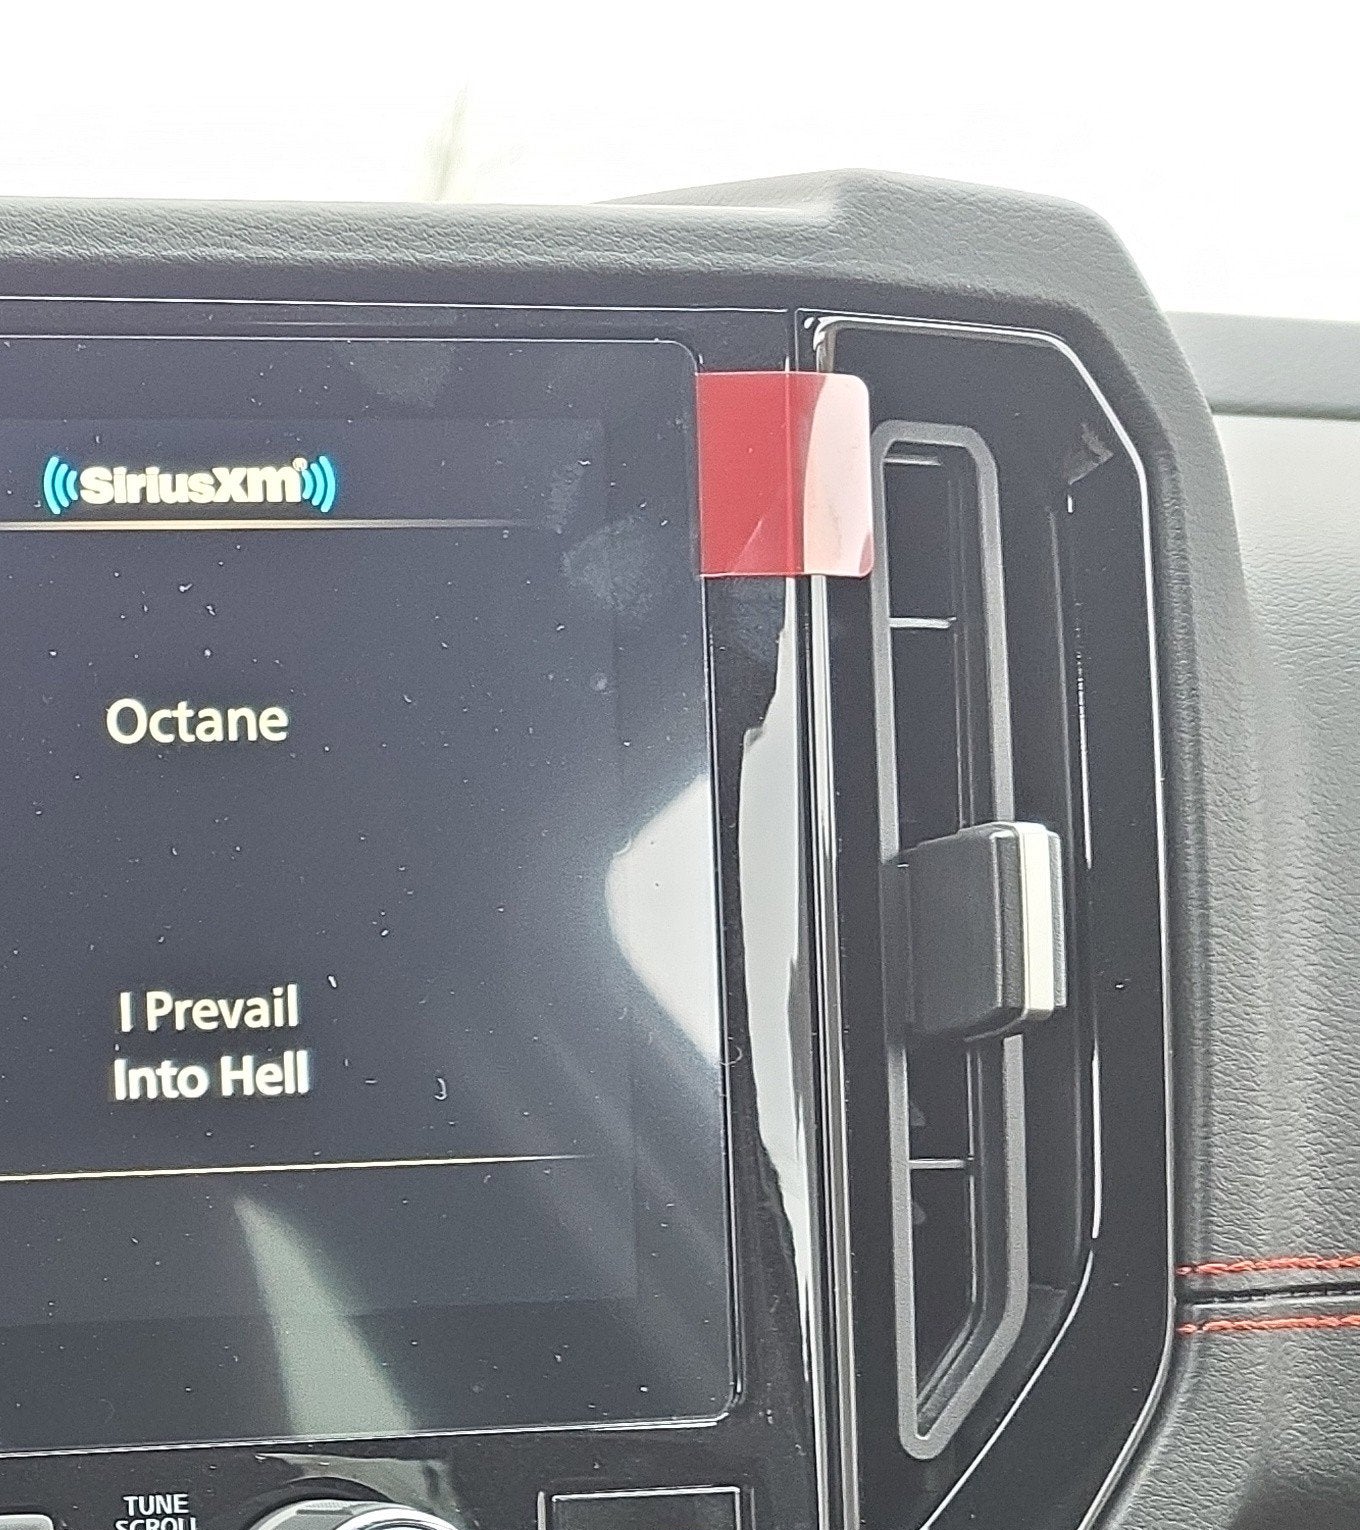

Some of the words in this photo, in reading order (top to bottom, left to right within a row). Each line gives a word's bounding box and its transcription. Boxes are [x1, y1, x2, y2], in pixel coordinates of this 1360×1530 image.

[106, 697, 289, 745] Octane
[119, 992, 131, 1032] I
[147, 986, 299, 1031] Prevail
[115, 1058, 208, 1101] Into
[220, 1051, 310, 1096] Hell
[123, 1494, 188, 1517] TUNE
